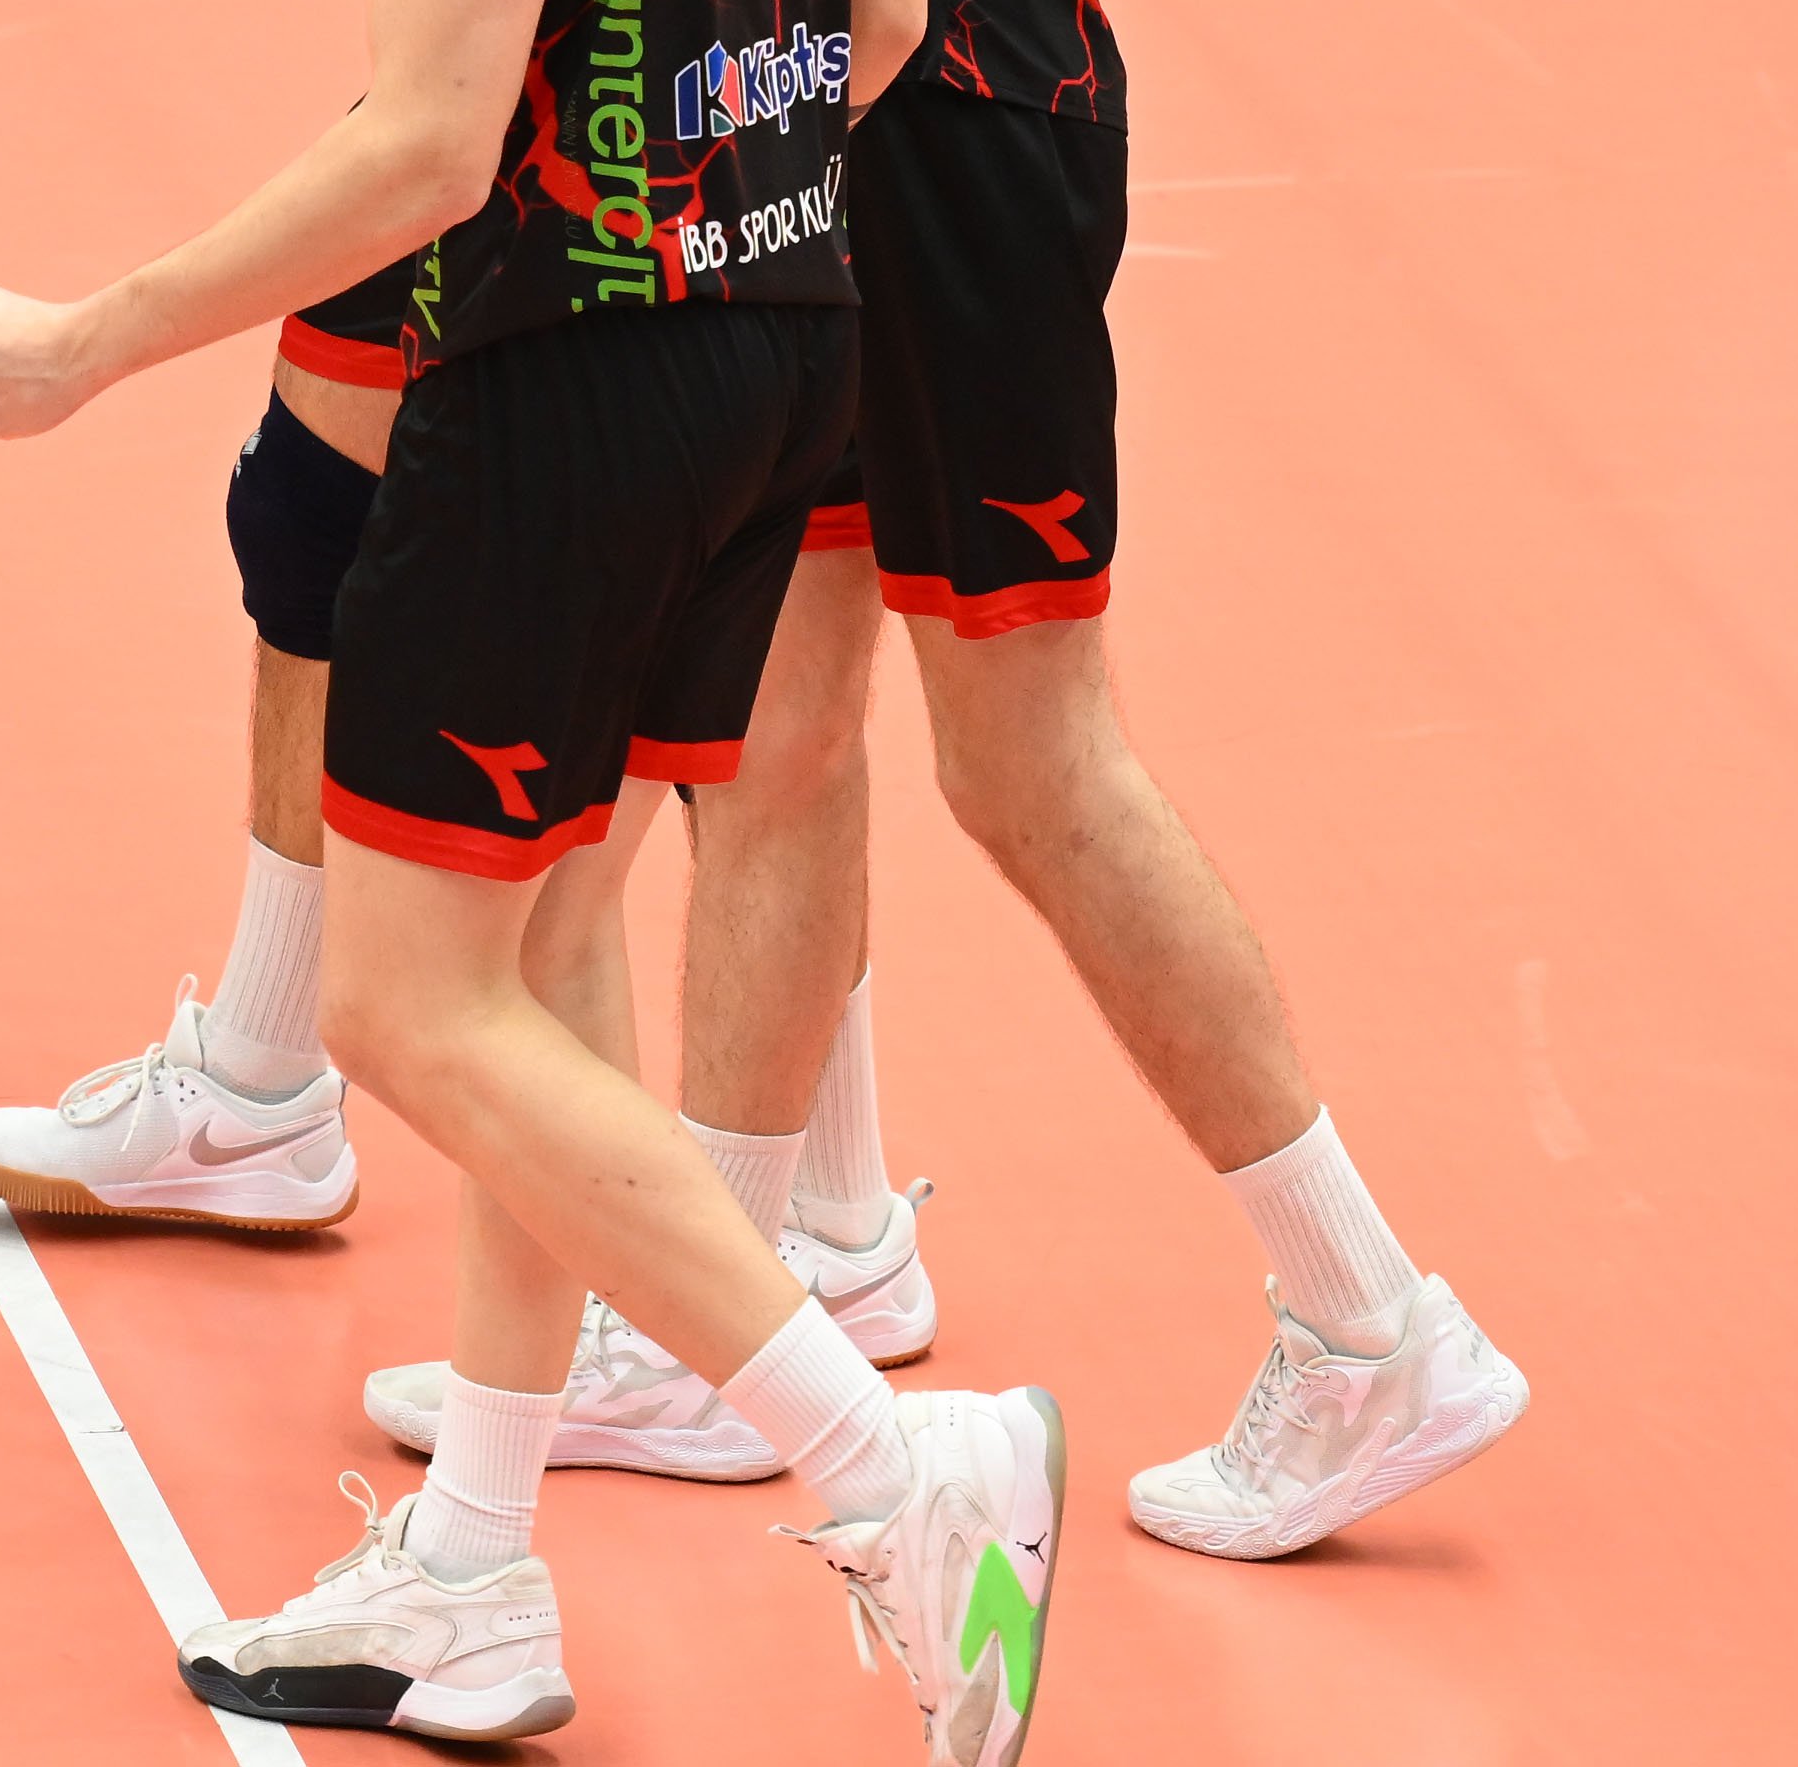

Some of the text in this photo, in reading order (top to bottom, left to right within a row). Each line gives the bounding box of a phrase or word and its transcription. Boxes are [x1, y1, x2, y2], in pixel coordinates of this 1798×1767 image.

[739, 22, 851, 135] Kiptş
[678, 216, 728, 274] İBB
[738, 197, 800, 264] SPOR
